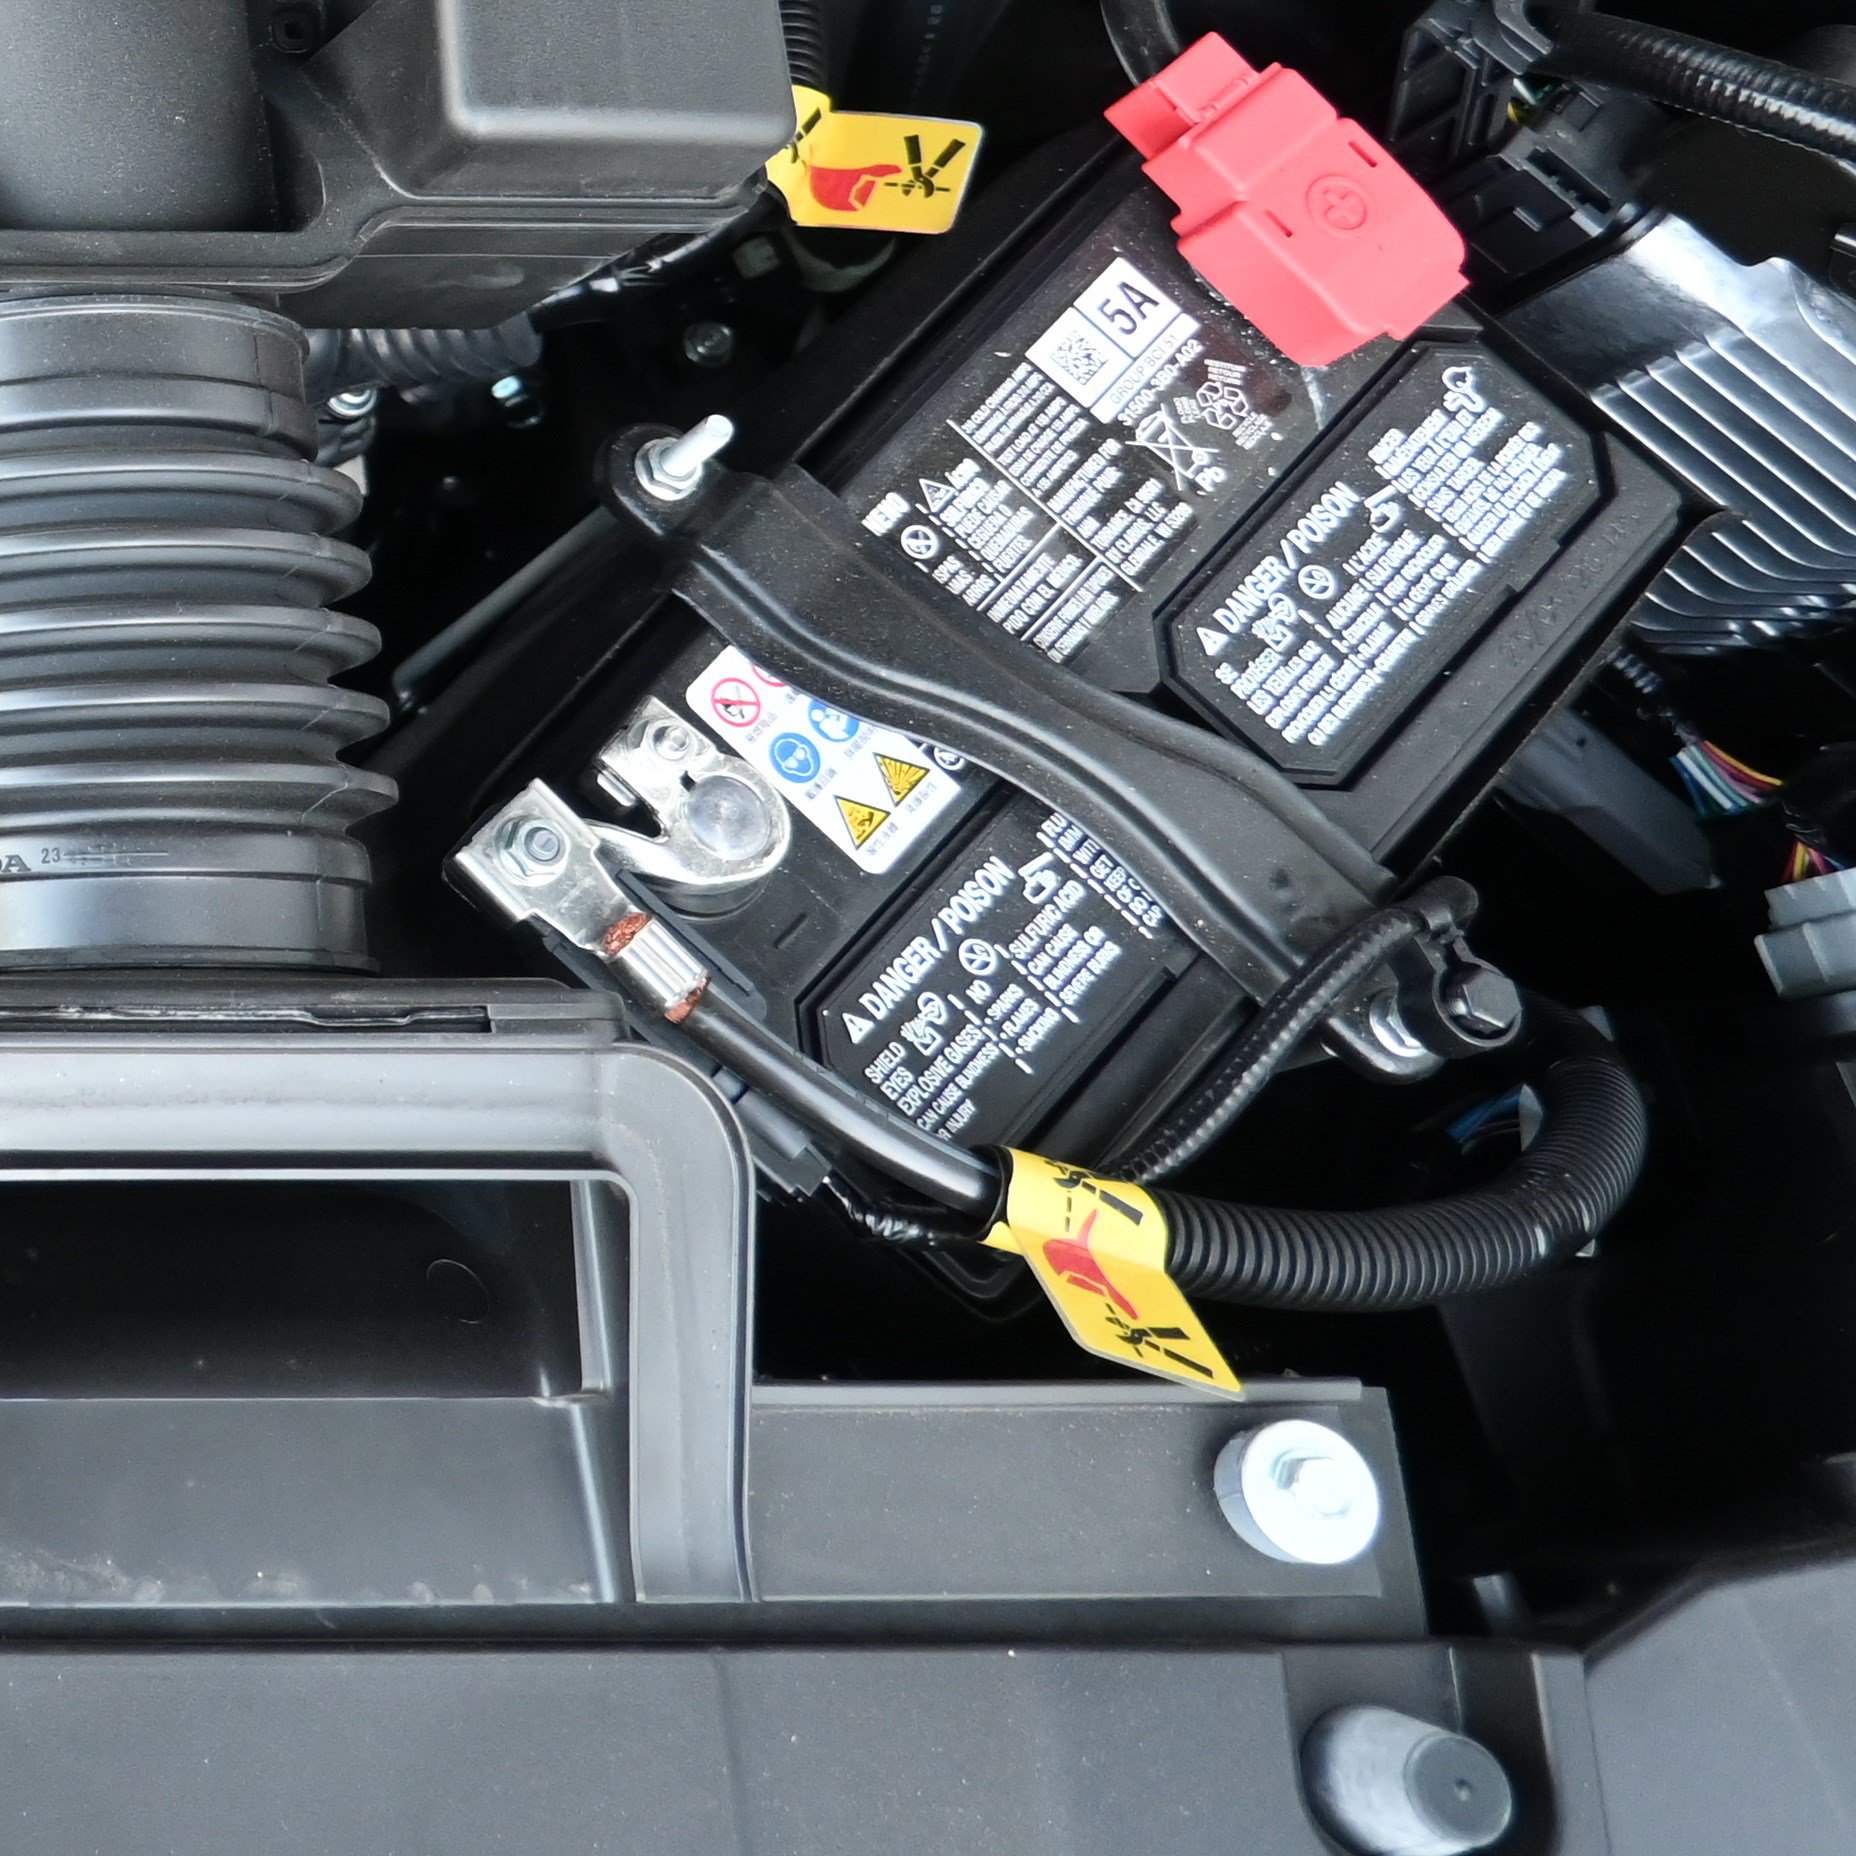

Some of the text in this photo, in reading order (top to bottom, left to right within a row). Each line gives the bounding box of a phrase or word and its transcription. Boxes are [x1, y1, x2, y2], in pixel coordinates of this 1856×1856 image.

[1097, 274, 1159, 336] 5A
[971, 362, 1031, 424] COLD CRANKING AMPS
[1109, 364, 1148, 404] GROUP
[1144, 345, 1166, 366] BCI
[1116, 339, 1204, 425] 31500-3B0-A02
[997, 447, 1017, 467] TEST
[1012, 432, 1031, 451] LOAD
[1044, 396, 1066, 417] AMPS
[1050, 403, 1082, 434] AMPS
[1047, 436, 1122, 516] MANUFACTURED FOR
[1197, 462, 1227, 493] Pb
[954, 479, 1012, 538] PUEDE CAUSAR
[1125, 497, 1143, 514] CA
[1164, 500, 1193, 529] 53209
[1426, 484, 1455, 513] SANS
[967, 511, 1007, 550] CEGUERA
[980, 507, 1034, 560] QUEMADURAS
[1104, 543, 1125, 563] BY
[1143, 499, 1166, 522] LLC
[1348, 532, 1388, 572] L'ACIDE
[1364, 529, 1421, 586] SULFURIQUE
[1021, 592, 1046, 616] CON
[1038, 582, 1053, 598] EL
[1325, 584, 1369, 628] AUCUNE
[1214, 661, 1238, 686] SE
[1229, 645, 1283, 699] PROTÉGER
[1247, 689, 1274, 716] LES
[40, 848, 61, 864] 23
[1089, 854, 1114, 879] GET
[1103, 865, 1129, 891] KEEP
[1008, 905, 1062, 959] SULFURIC
[1051, 877, 1086, 912] ACID
[1128, 894, 1149, 915] DO
[1026, 923, 1078, 976] CAN CAUSE
[1042, 924, 1105, 989] BLINDNESS OR
[966, 977, 993, 1005] NO
[1058, 940, 1121, 1005] SEVERE BURNS
[985, 982, 1024, 1021] SPARKS
[1001, 997, 1040, 1037] FLAMES
[1016, 1007, 1060, 1051] SMOKING
[864, 1041, 906, 1082] SHIELD
[895, 1023, 982, 1114] EXPLOSIVE GASES
[880, 1066, 914, 1100] EYES
[915, 1042, 999, 1130] CAN CAUSE BLINDNESS
[943, 1098, 977, 1132] INJURY
